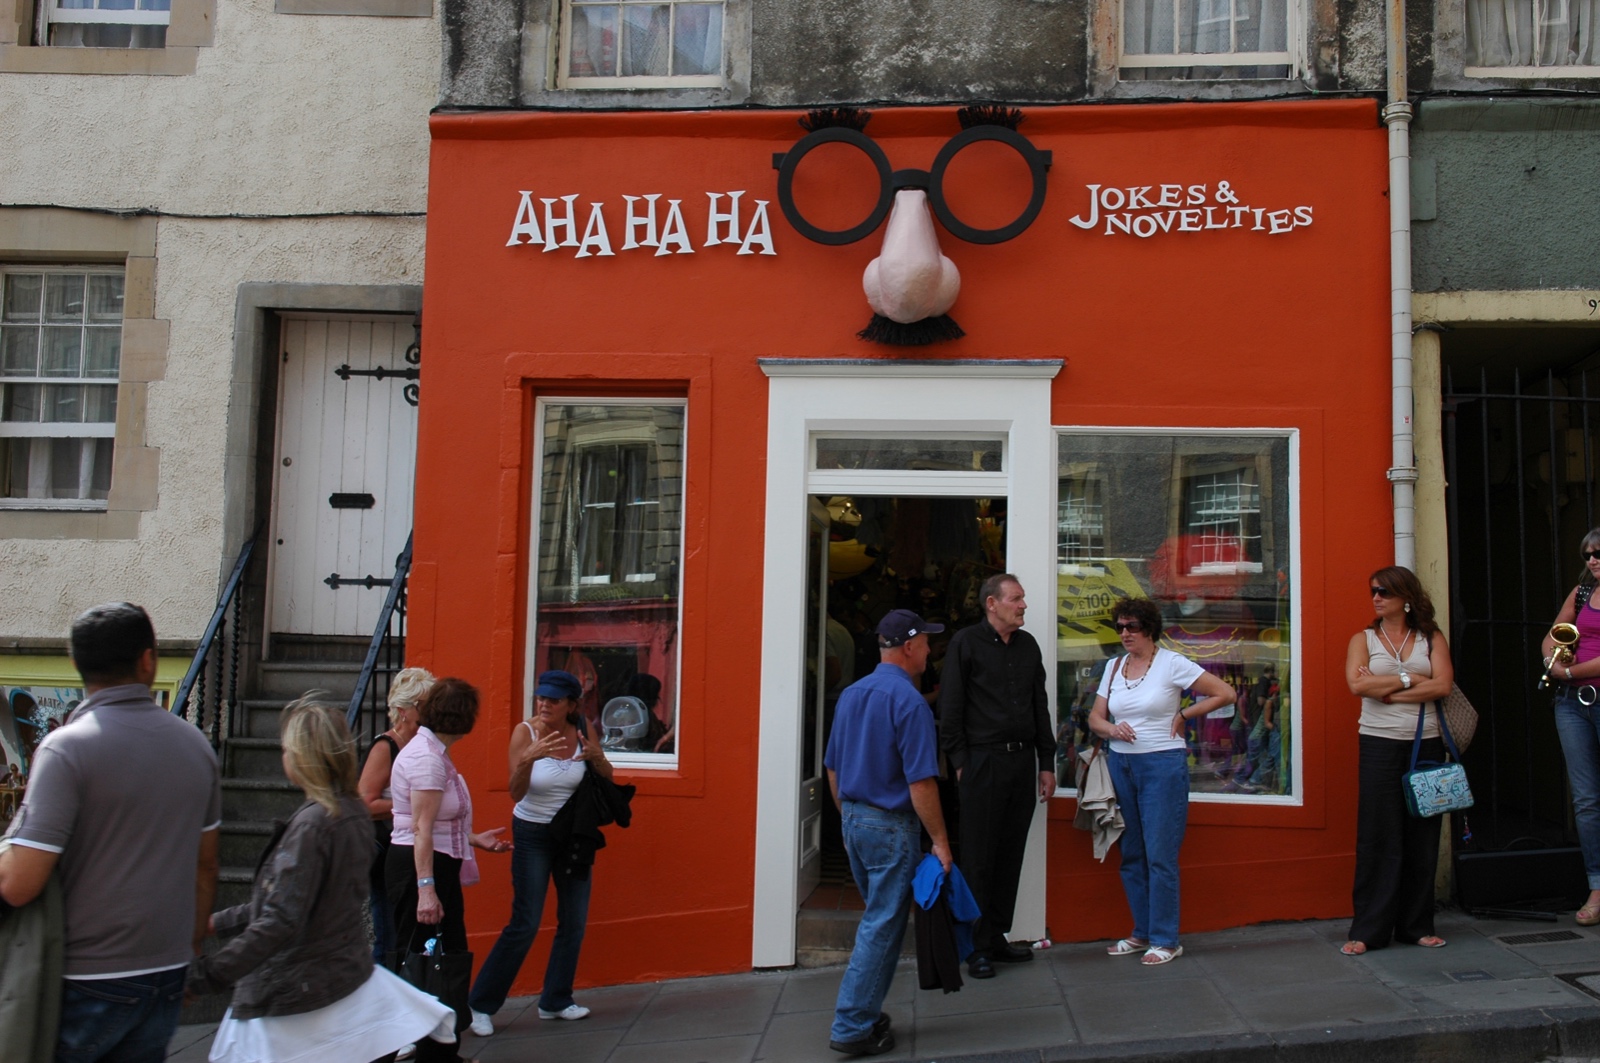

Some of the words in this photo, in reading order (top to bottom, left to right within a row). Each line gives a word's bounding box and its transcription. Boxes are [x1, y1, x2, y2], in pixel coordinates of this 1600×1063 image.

[1069, 184, 1207, 230] JOKES
[1214, 180, 1240, 205] &
[1103, 205, 1314, 238] NOVELTIES
[505, 190, 616, 259] AHA
[620, 193, 696, 257] HA
[703, 190, 778, 256] HA
[1588, 299, 1600, 316] 9
[1078, 592, 1111, 610] £100
